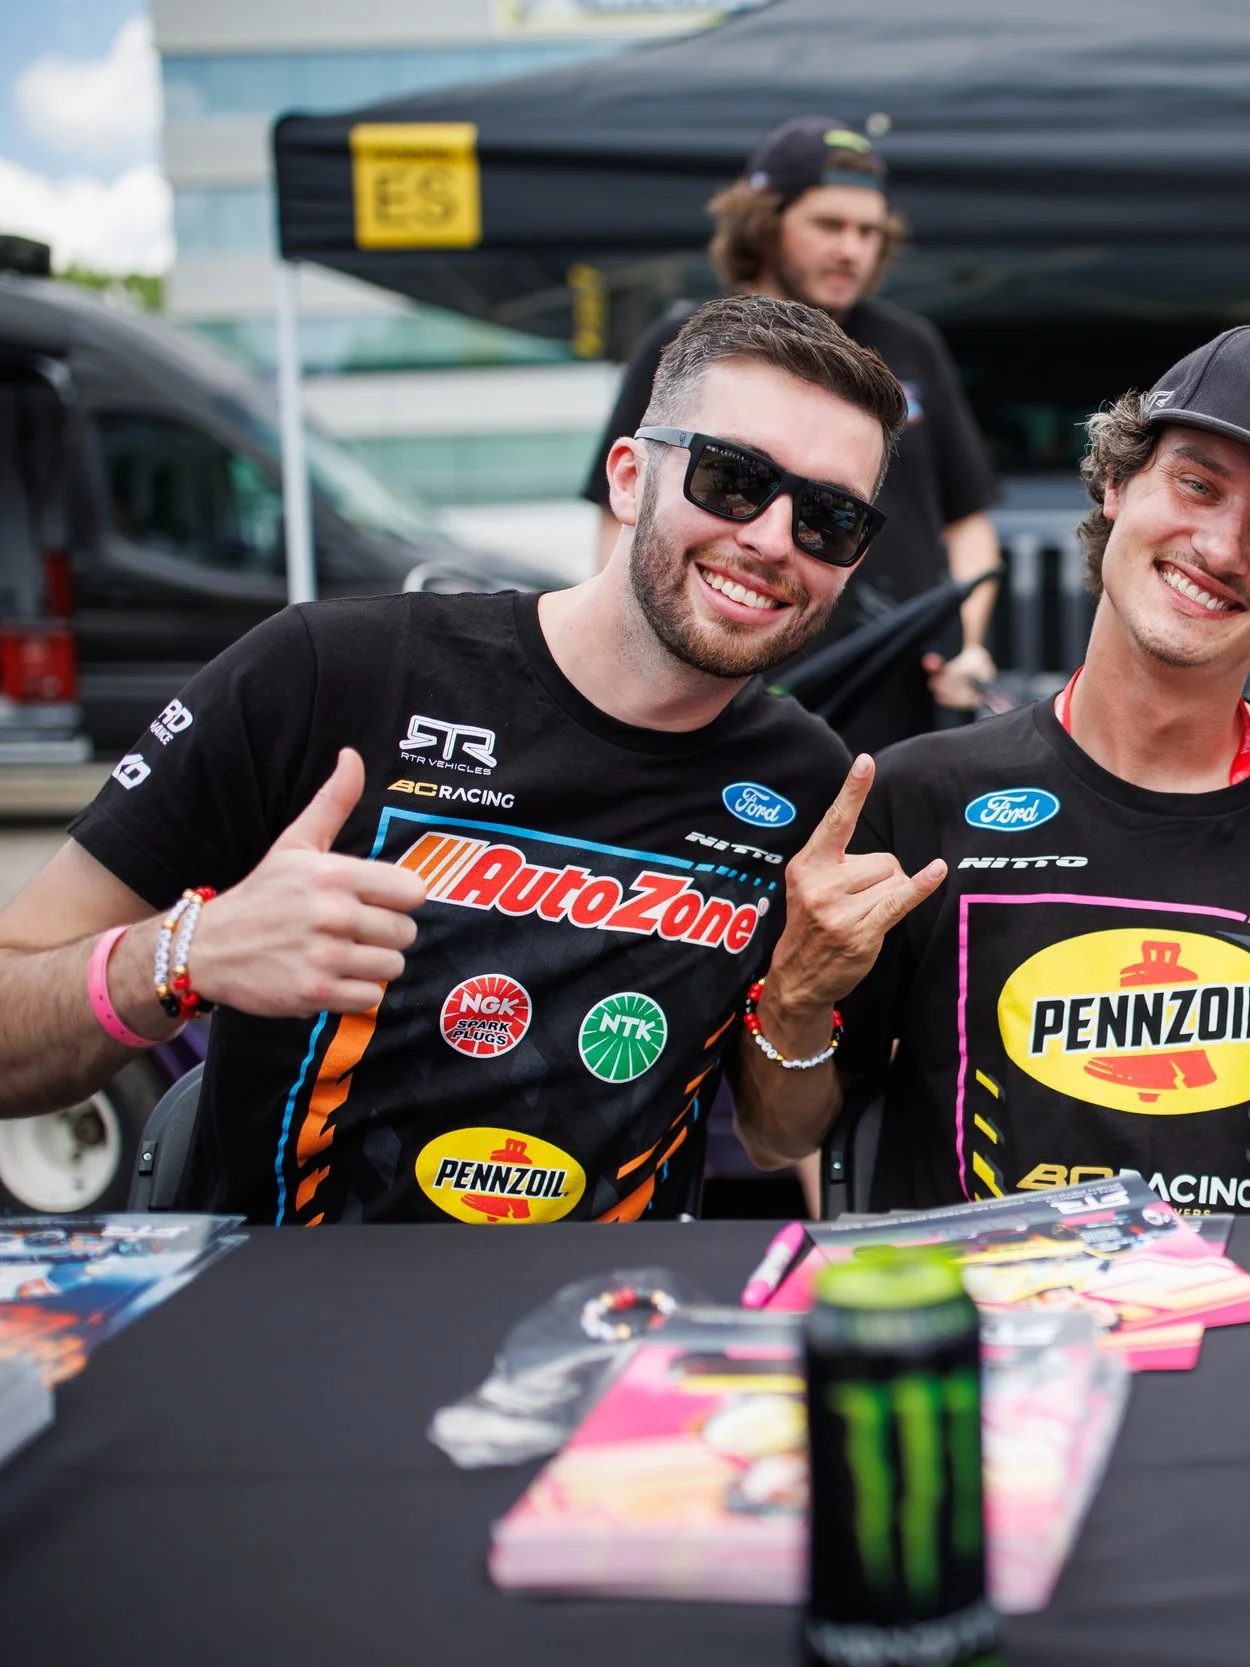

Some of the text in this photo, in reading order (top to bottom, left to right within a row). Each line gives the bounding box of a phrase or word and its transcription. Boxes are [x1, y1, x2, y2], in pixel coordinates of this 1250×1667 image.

[373, 170, 461, 231] ES
[399, 714, 498, 769] RTR
[400, 751, 492, 776] RTR VEHICLES
[734, 787, 783, 823] Ford
[979, 794, 1041, 824] Ford
[684, 831, 784, 865] NITTO
[957, 855, 1089, 869] NITTO
[446, 844, 759, 953] AutoZone
[459, 991, 520, 1017] NGK
[452, 1029, 508, 1046] PLUGS
[456, 1019, 511, 1034] SPARK
[599, 1011, 656, 1043] NTK
[433, 1157, 567, 1199] PENNZOIL
